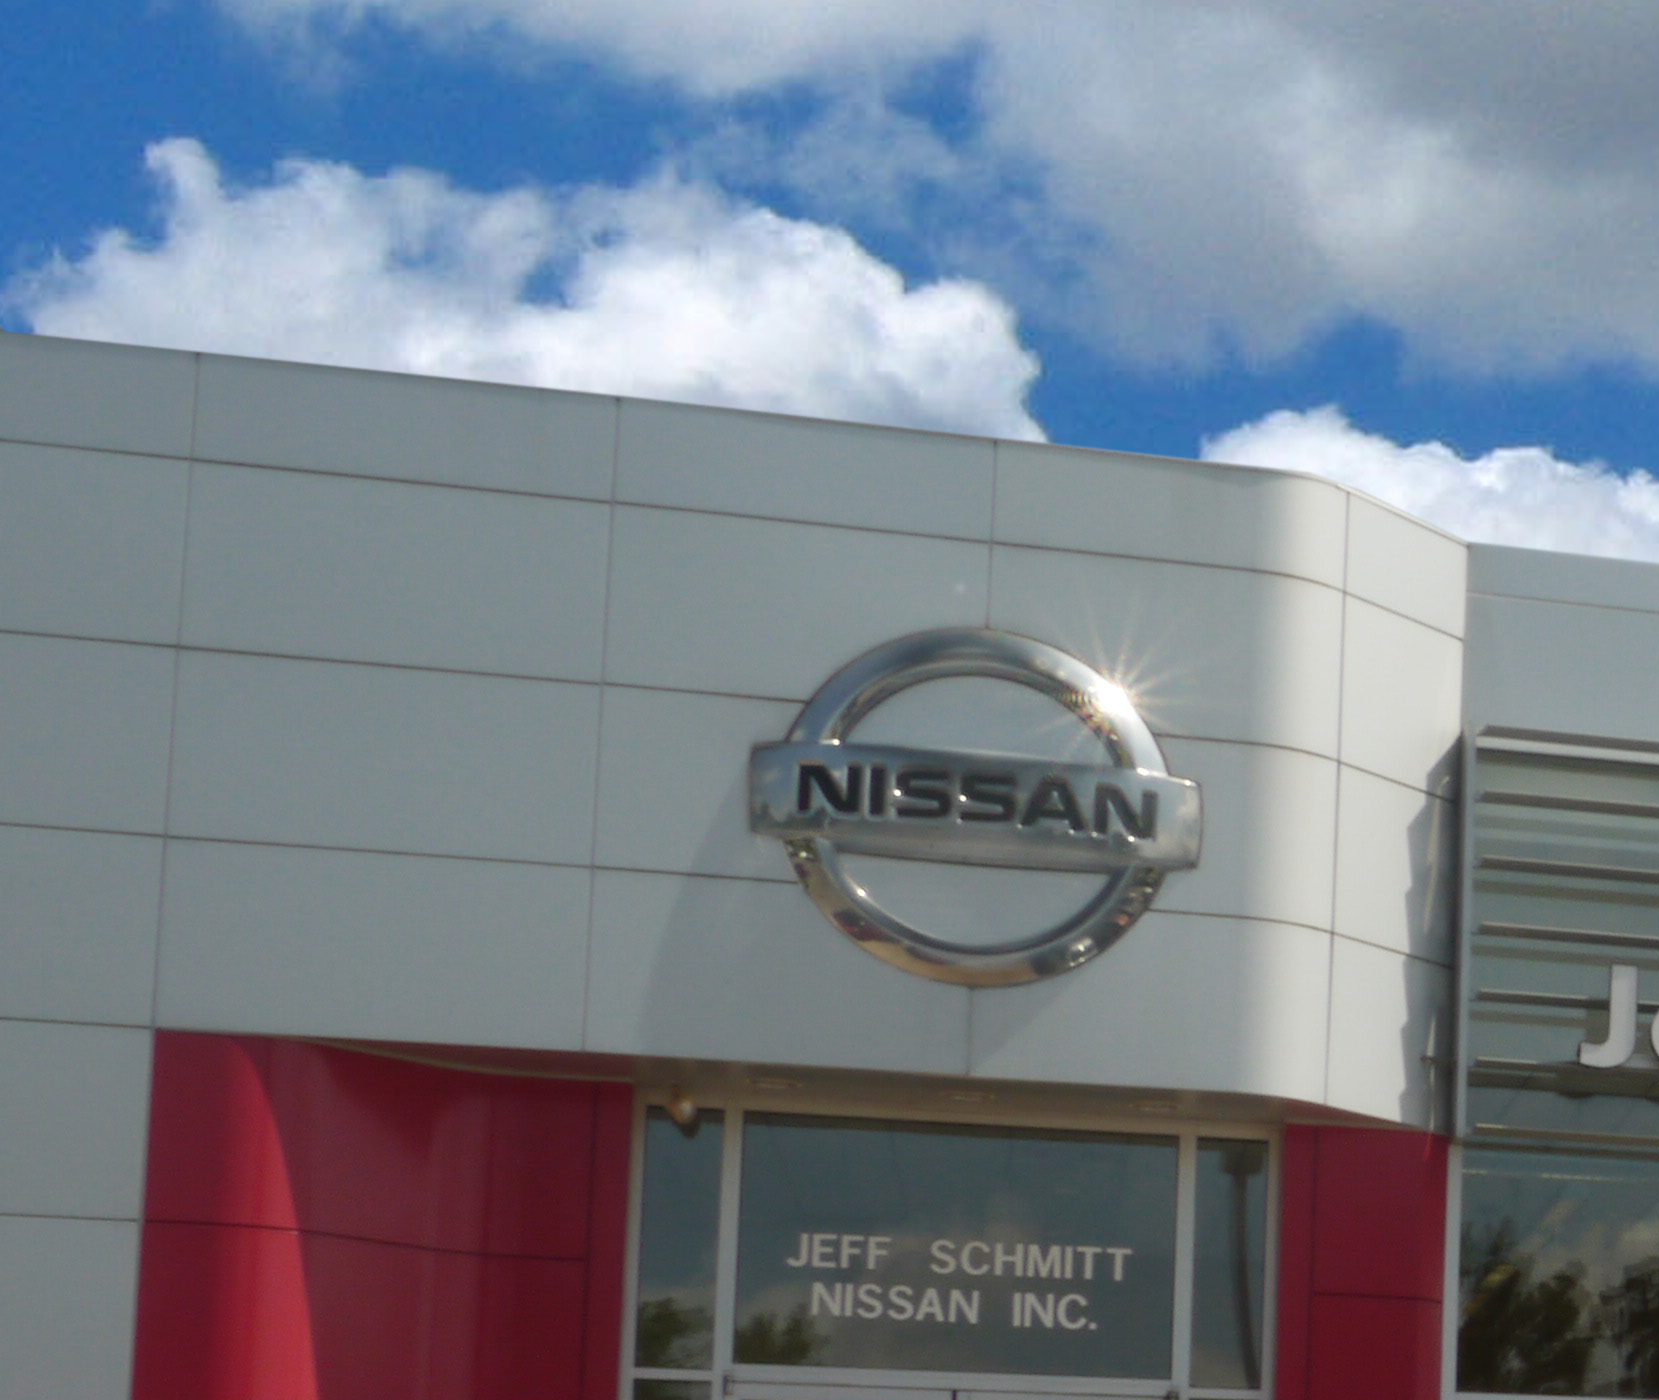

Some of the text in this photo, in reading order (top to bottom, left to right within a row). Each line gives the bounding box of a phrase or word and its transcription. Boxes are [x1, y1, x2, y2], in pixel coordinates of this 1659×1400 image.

[796, 762, 1157, 843] NISSAN
[786, 1232, 1133, 1283] JEFF SCHMITT
[810, 1282, 1098, 1331] NISSAN INC.
